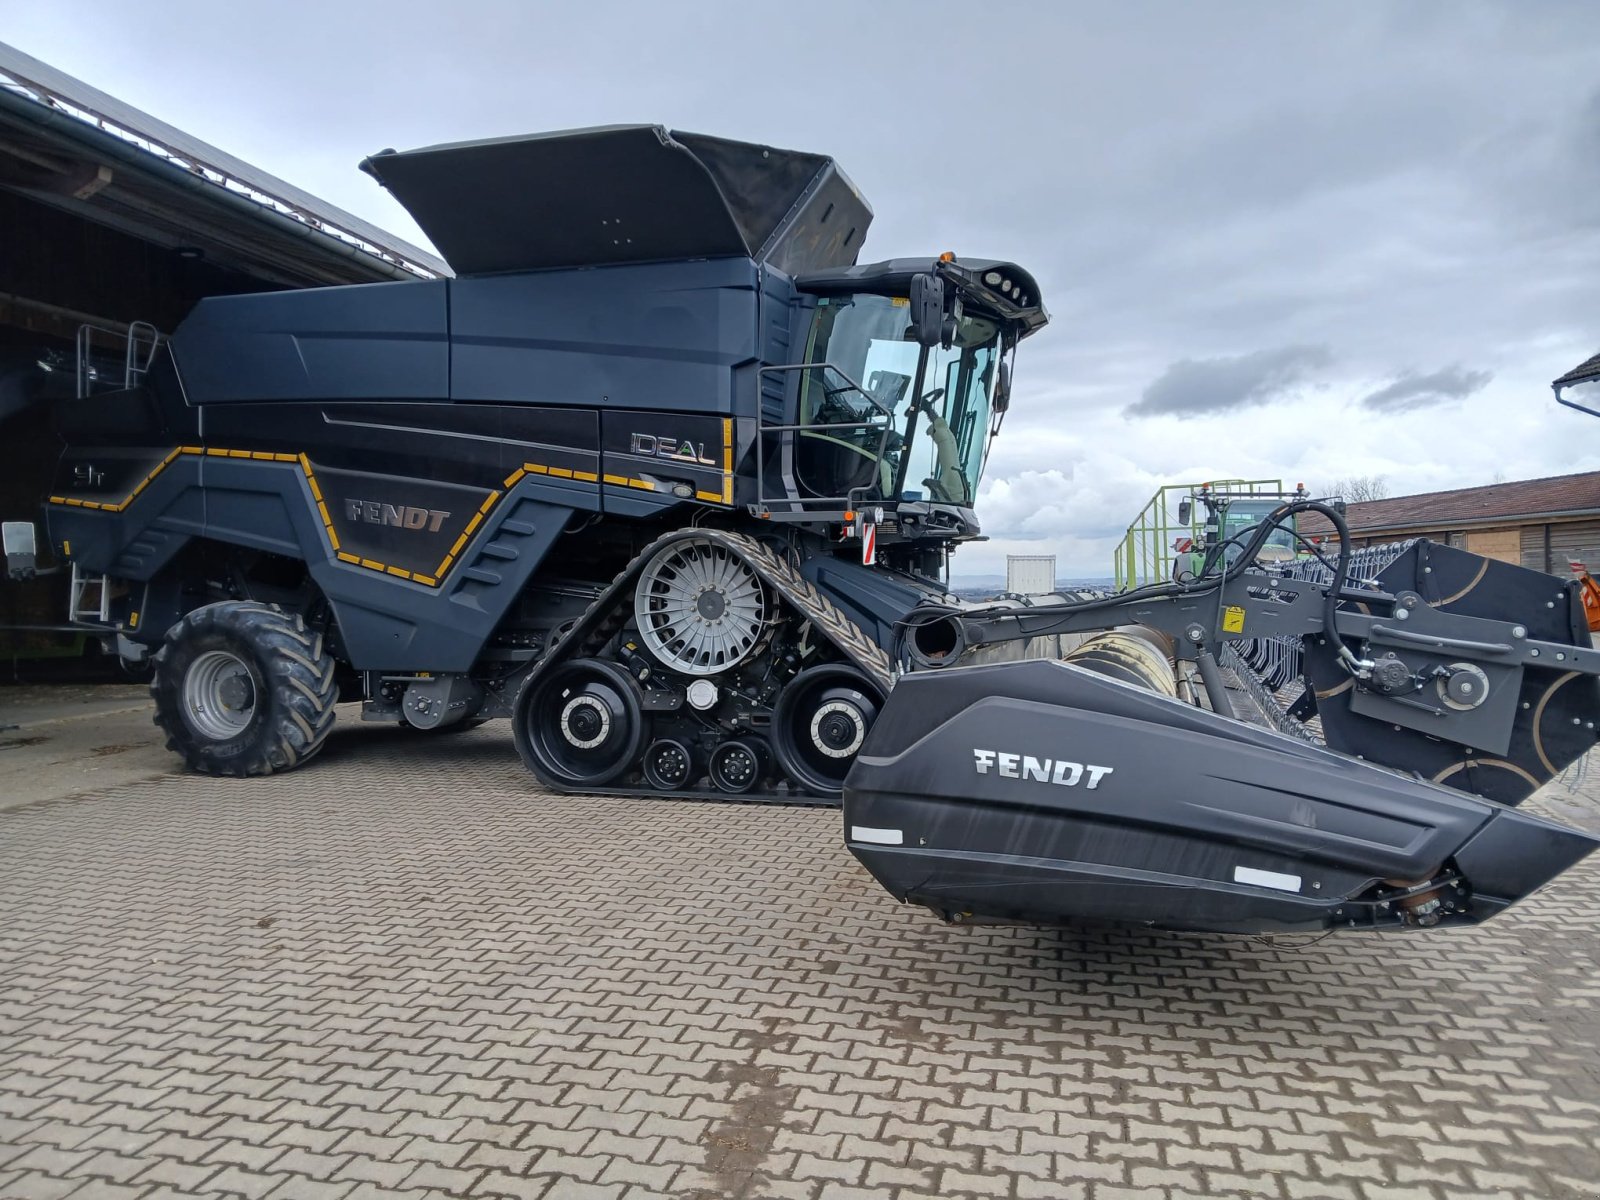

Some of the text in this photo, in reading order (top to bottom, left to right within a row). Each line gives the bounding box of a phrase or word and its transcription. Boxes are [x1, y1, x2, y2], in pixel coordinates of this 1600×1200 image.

[631, 432, 716, 465] IDEAL
[344, 498, 452, 533] FENDT
[973, 749, 1114, 790] FENDT
